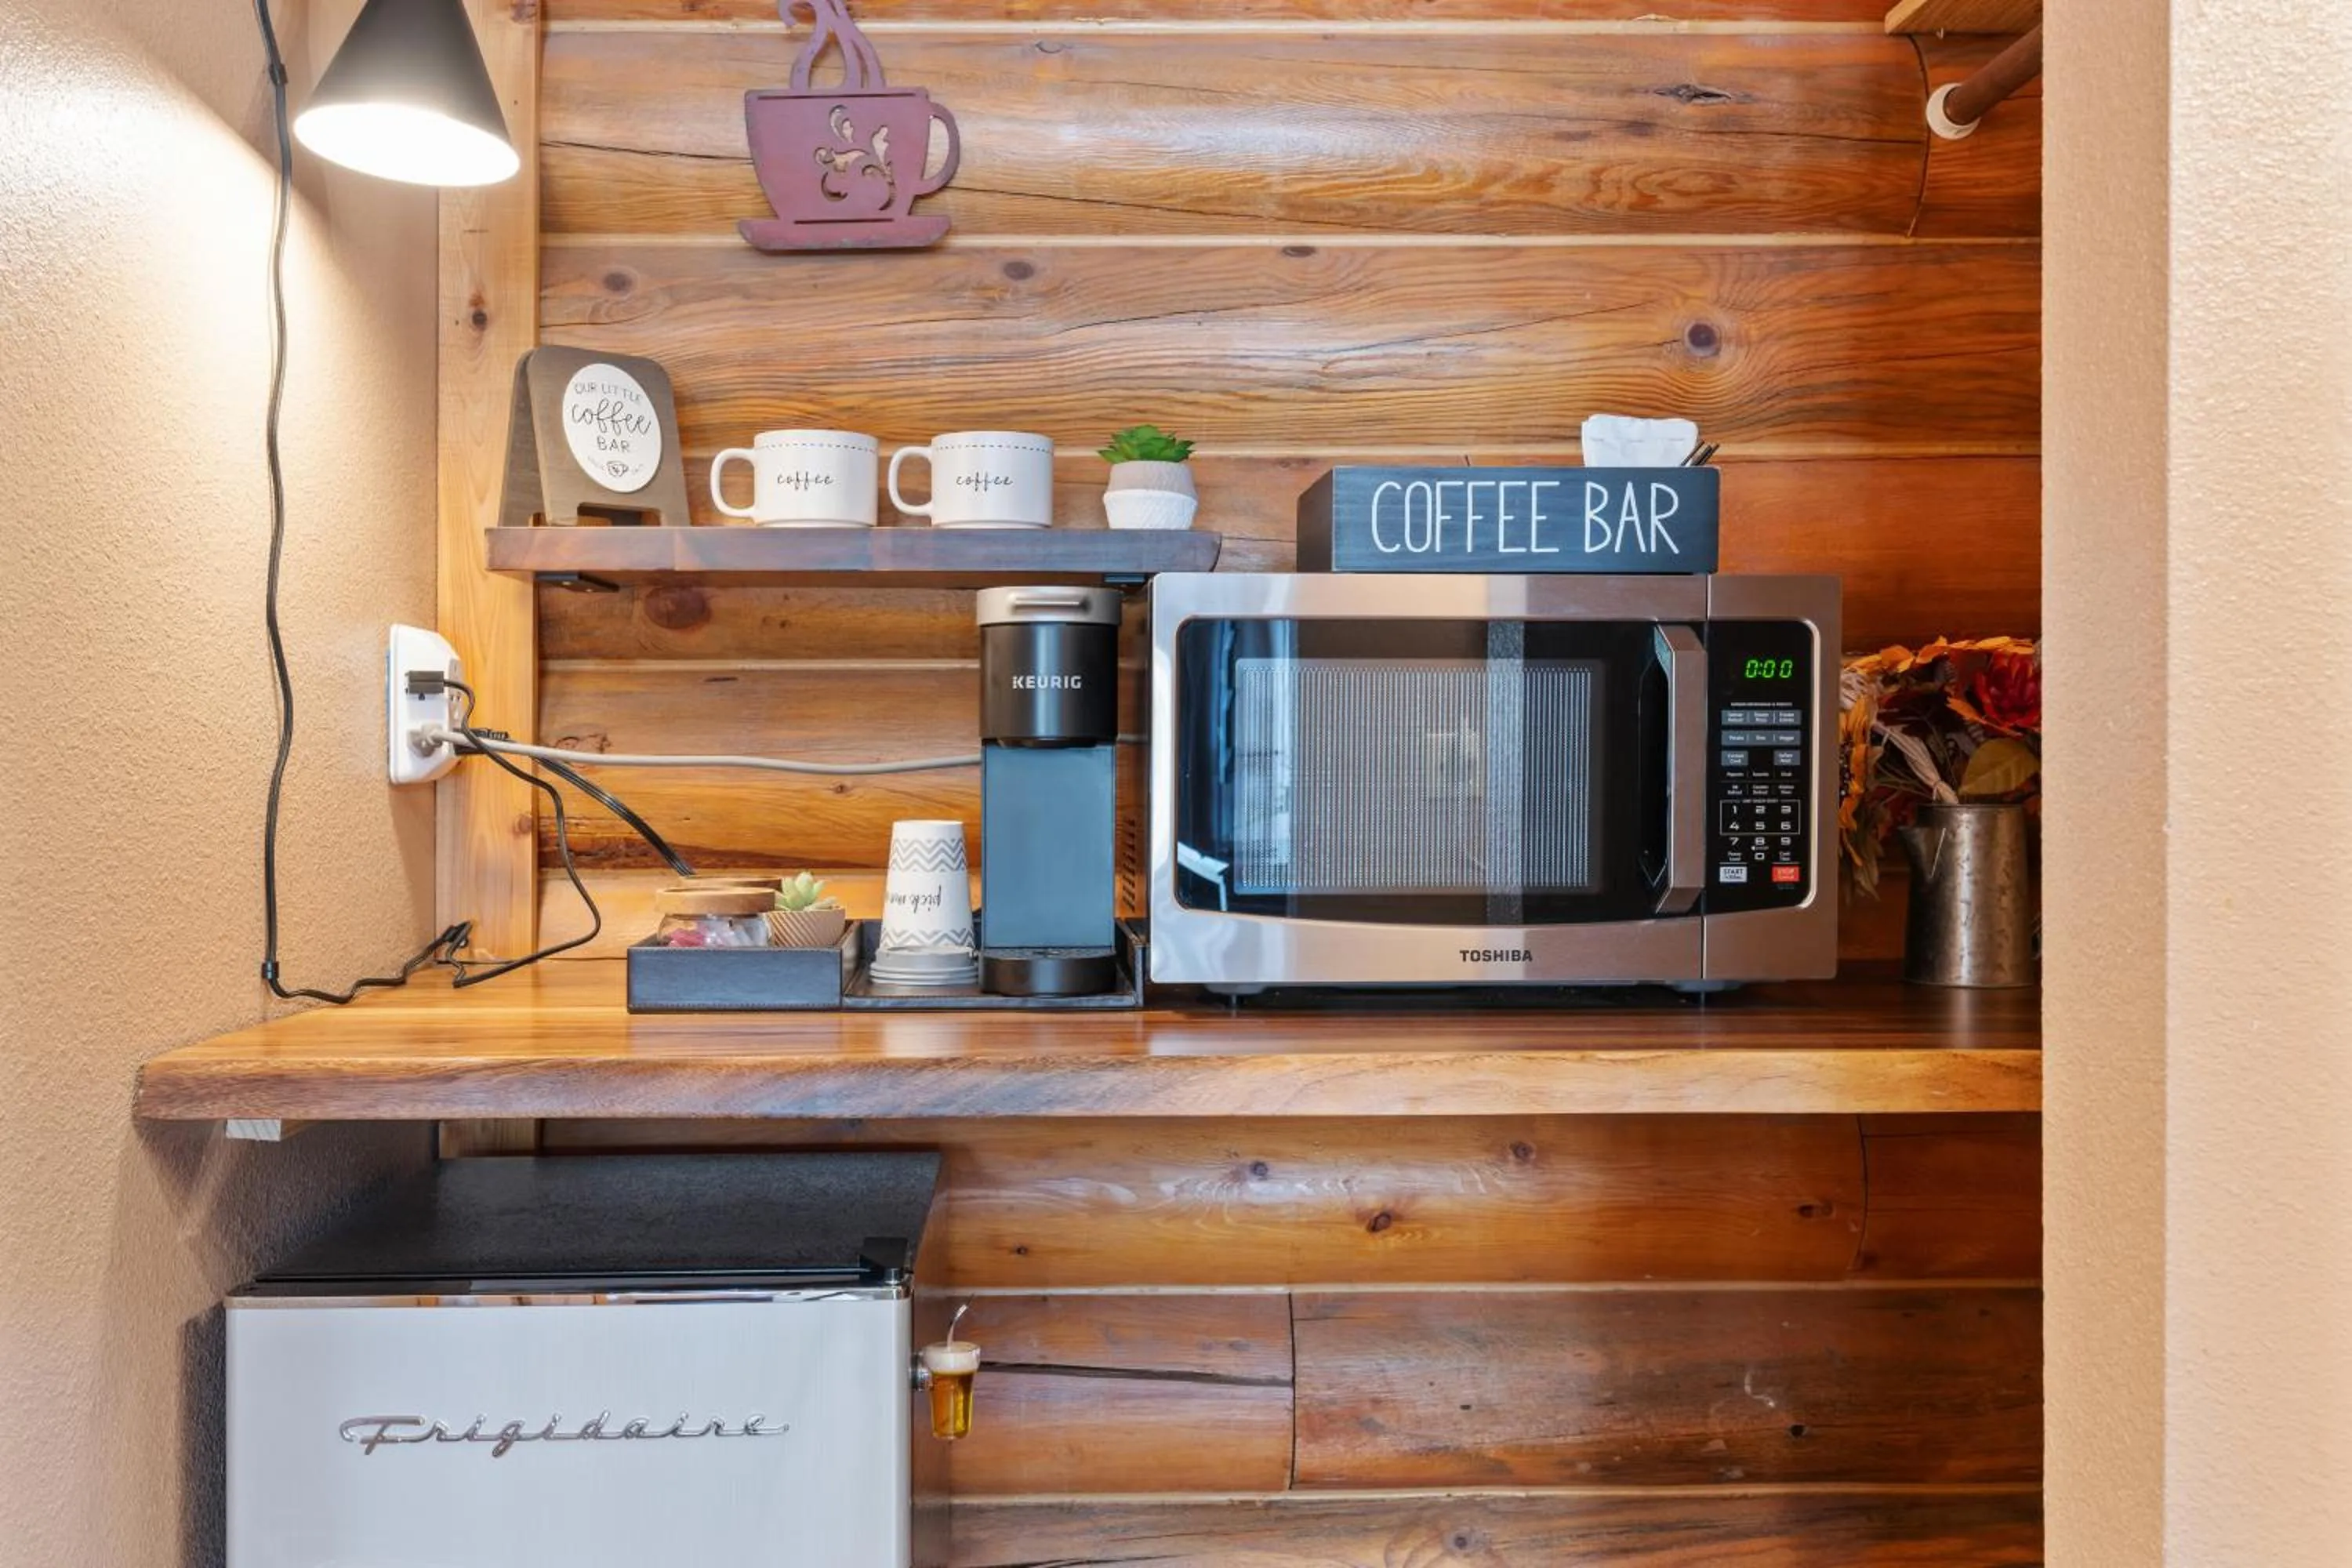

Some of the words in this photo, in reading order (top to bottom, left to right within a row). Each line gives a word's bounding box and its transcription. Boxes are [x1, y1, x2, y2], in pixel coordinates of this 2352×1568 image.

[574, 382, 597, 394] OUR
[572, 397, 652, 436] coffee
[597, 435, 630, 452] BAR
[777, 470, 834, 491] coffee
[956, 471, 1014, 492] coffee
[1371, 480, 1560, 554] COFFEE
[1584, 480, 1680, 554] BAR
[1745, 659, 1794, 679] 0:00
[1012, 675, 1082, 689] KEURIG
[1732, 805, 1738, 815] 1
[1755, 805, 1766, 815] 2
[1780, 805, 1791, 815] 3
[1729, 821, 1740, 831] 4
[1755, 821, 1766, 830] 5
[1780, 821, 1791, 830] 6
[1729, 837, 1739, 846] 7
[1755, 837, 1765, 846] 8
[1780, 837, 1791, 846] 9
[908, 884, 942, 914] pick
[1459, 949, 1533, 962] TOSHIBA
[339, 1410, 789, 1458] Frigidaire
